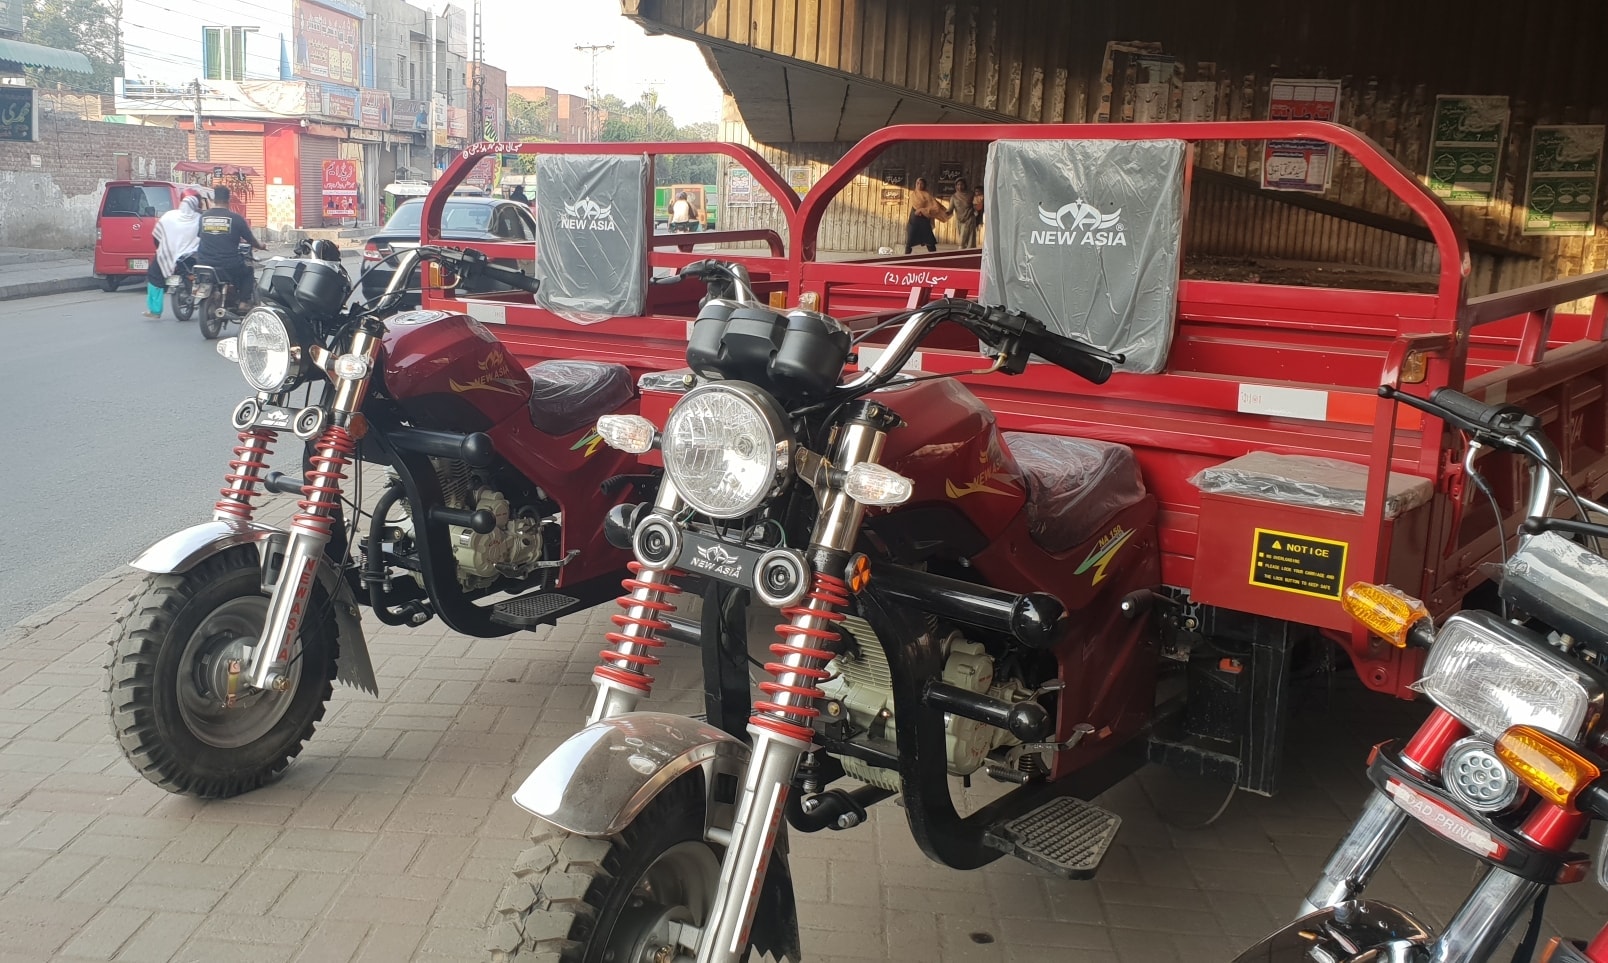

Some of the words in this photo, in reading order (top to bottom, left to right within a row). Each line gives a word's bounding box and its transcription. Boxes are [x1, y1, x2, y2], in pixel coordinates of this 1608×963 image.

[561, 219, 586, 230] NEW
[589, 219, 616, 232] ASIA
[1030, 230, 1074, 246] NEW
[1080, 231, 1127, 247] ASIA
[474, 373, 493, 386] NEW
[494, 365, 510, 379] ASIA
[973, 464, 992, 485] NEW
[1286, 543, 1330, 558] NOTICE
[690, 557, 715, 570] NEW
[715, 564, 740, 579] ASIA
[297, 559, 316, 599] NEW
[278, 602, 301, 661] ASIA
